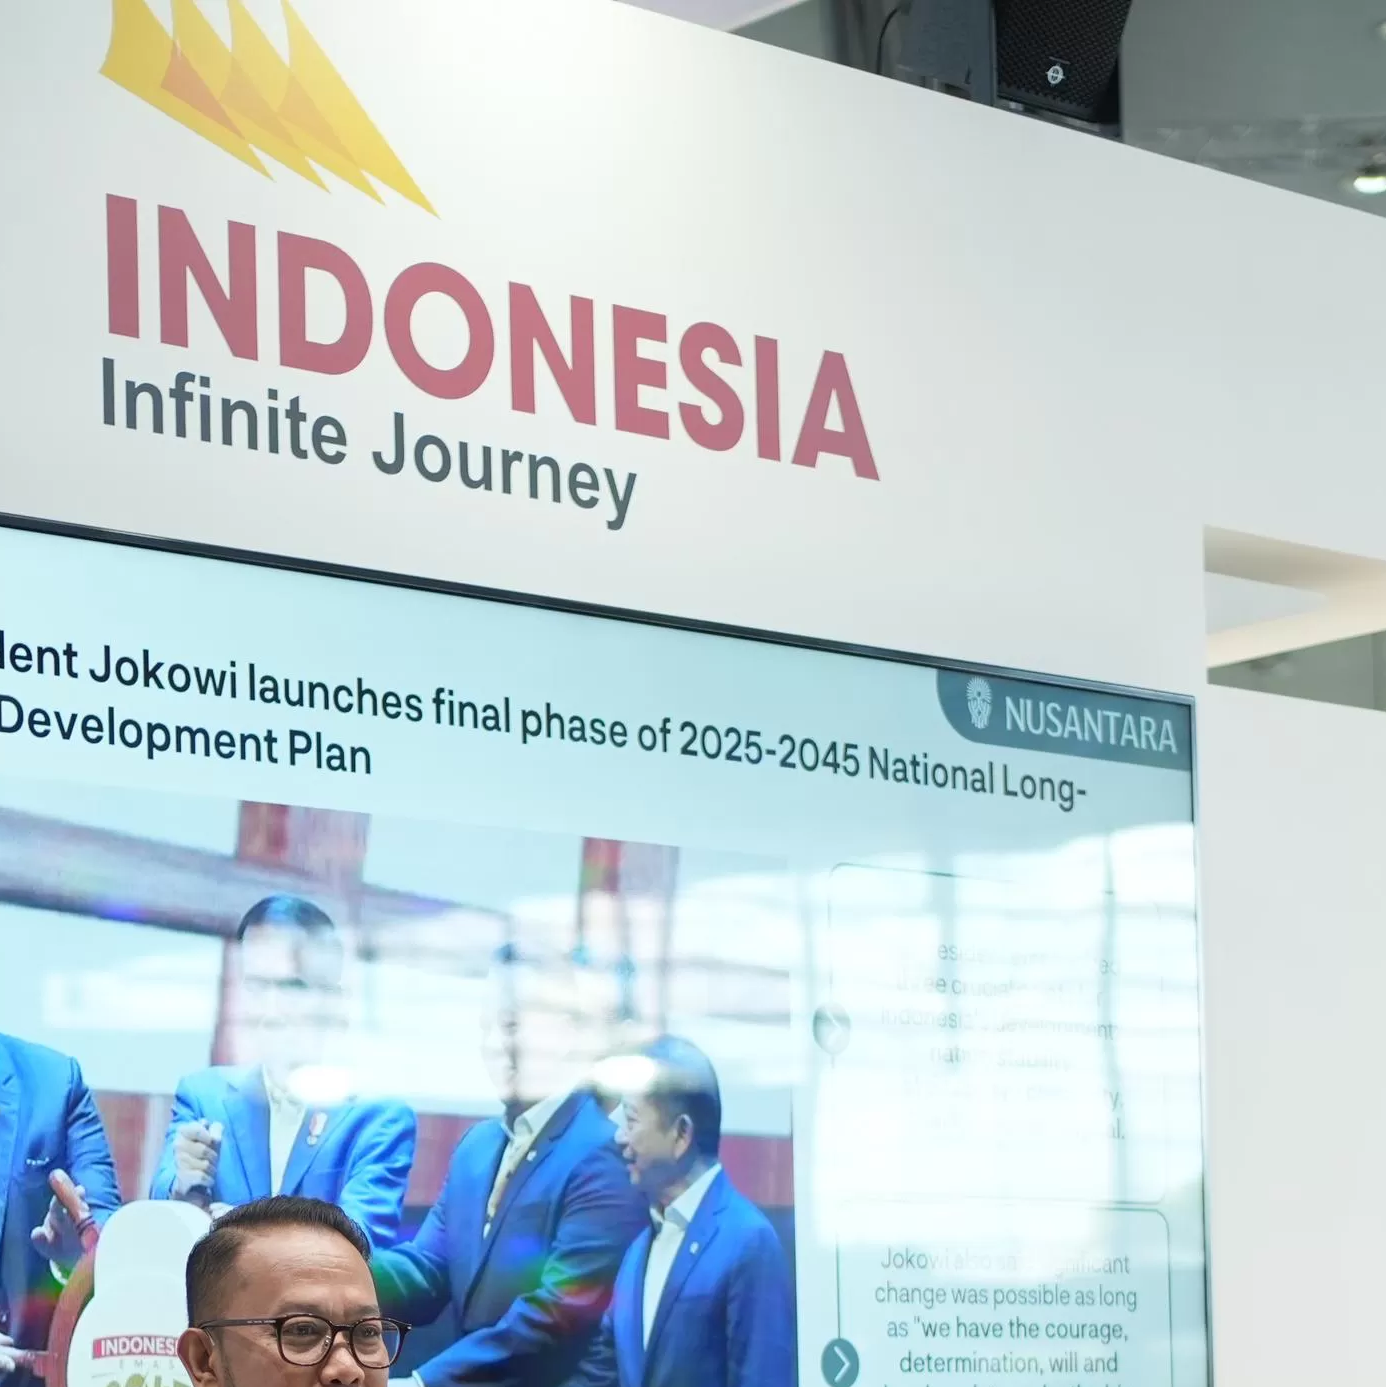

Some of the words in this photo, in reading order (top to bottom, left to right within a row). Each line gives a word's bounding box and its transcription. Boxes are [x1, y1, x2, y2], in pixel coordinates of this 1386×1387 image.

[106, 193, 881, 480] INDONESIA
[102, 357, 348, 465] Infinite
[372, 411, 638, 531] Journey
[90, 645, 238, 699] Jokowi
[247, 663, 424, 722] launches
[432, 688, 511, 733] final
[520, 703, 628, 747] phase
[637, 717, 671, 752] of
[679, 721, 860, 777] 2025-2045
[868, 746, 995, 794] National
[1003, 764, 1087, 812] Long-
[1005, 696, 1178, 754] NUSANTARA
[289, 729, 372, 774] Plan
[874, 1280, 947, 1310] change
[951, 1288, 989, 1306] was
[993, 1283, 1071, 1310] possible
[1075, 1290, 1095, 1307] as
[1099, 1285, 1137, 1313] long
[101, 1335, 179, 1355] INDONESI
[887, 1322, 909, 1339] as
[914, 1317, 951, 1339] "we
[956, 1317, 1003, 1340] have
[1009, 1317, 1040, 1340] the
[1045, 1322, 1129, 1345] courage,
[899, 1351, 1045, 1378] determination,
[1048, 1352, 1079, 1374] will
[1084, 1352, 1119, 1374] and
